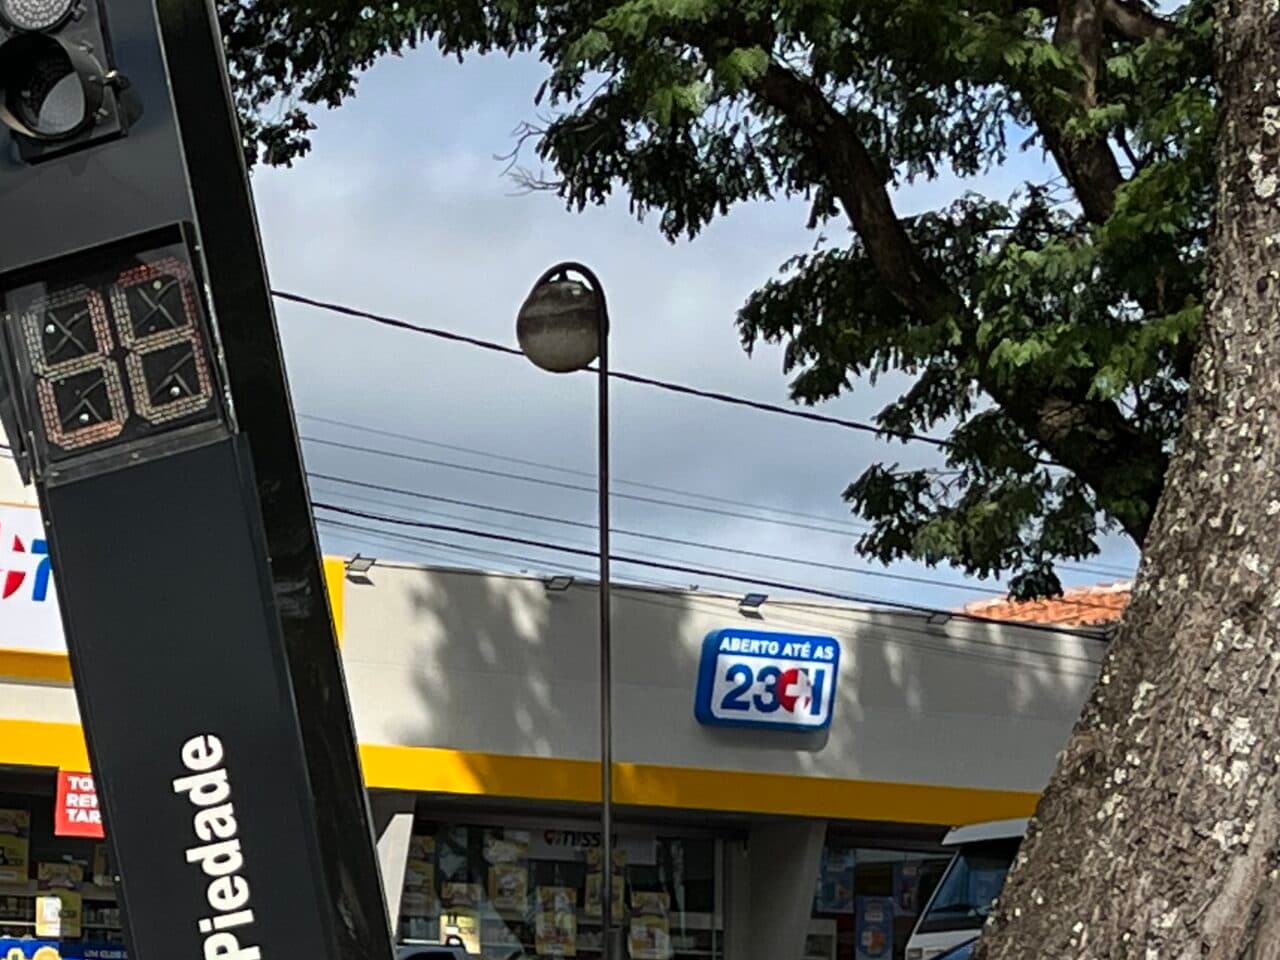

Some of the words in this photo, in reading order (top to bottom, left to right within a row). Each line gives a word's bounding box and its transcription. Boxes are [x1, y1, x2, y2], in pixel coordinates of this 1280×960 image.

[720, 637, 779, 656] ABERTO
[781, 641, 811, 659] ATÉ
[812, 645, 834, 660] AS
